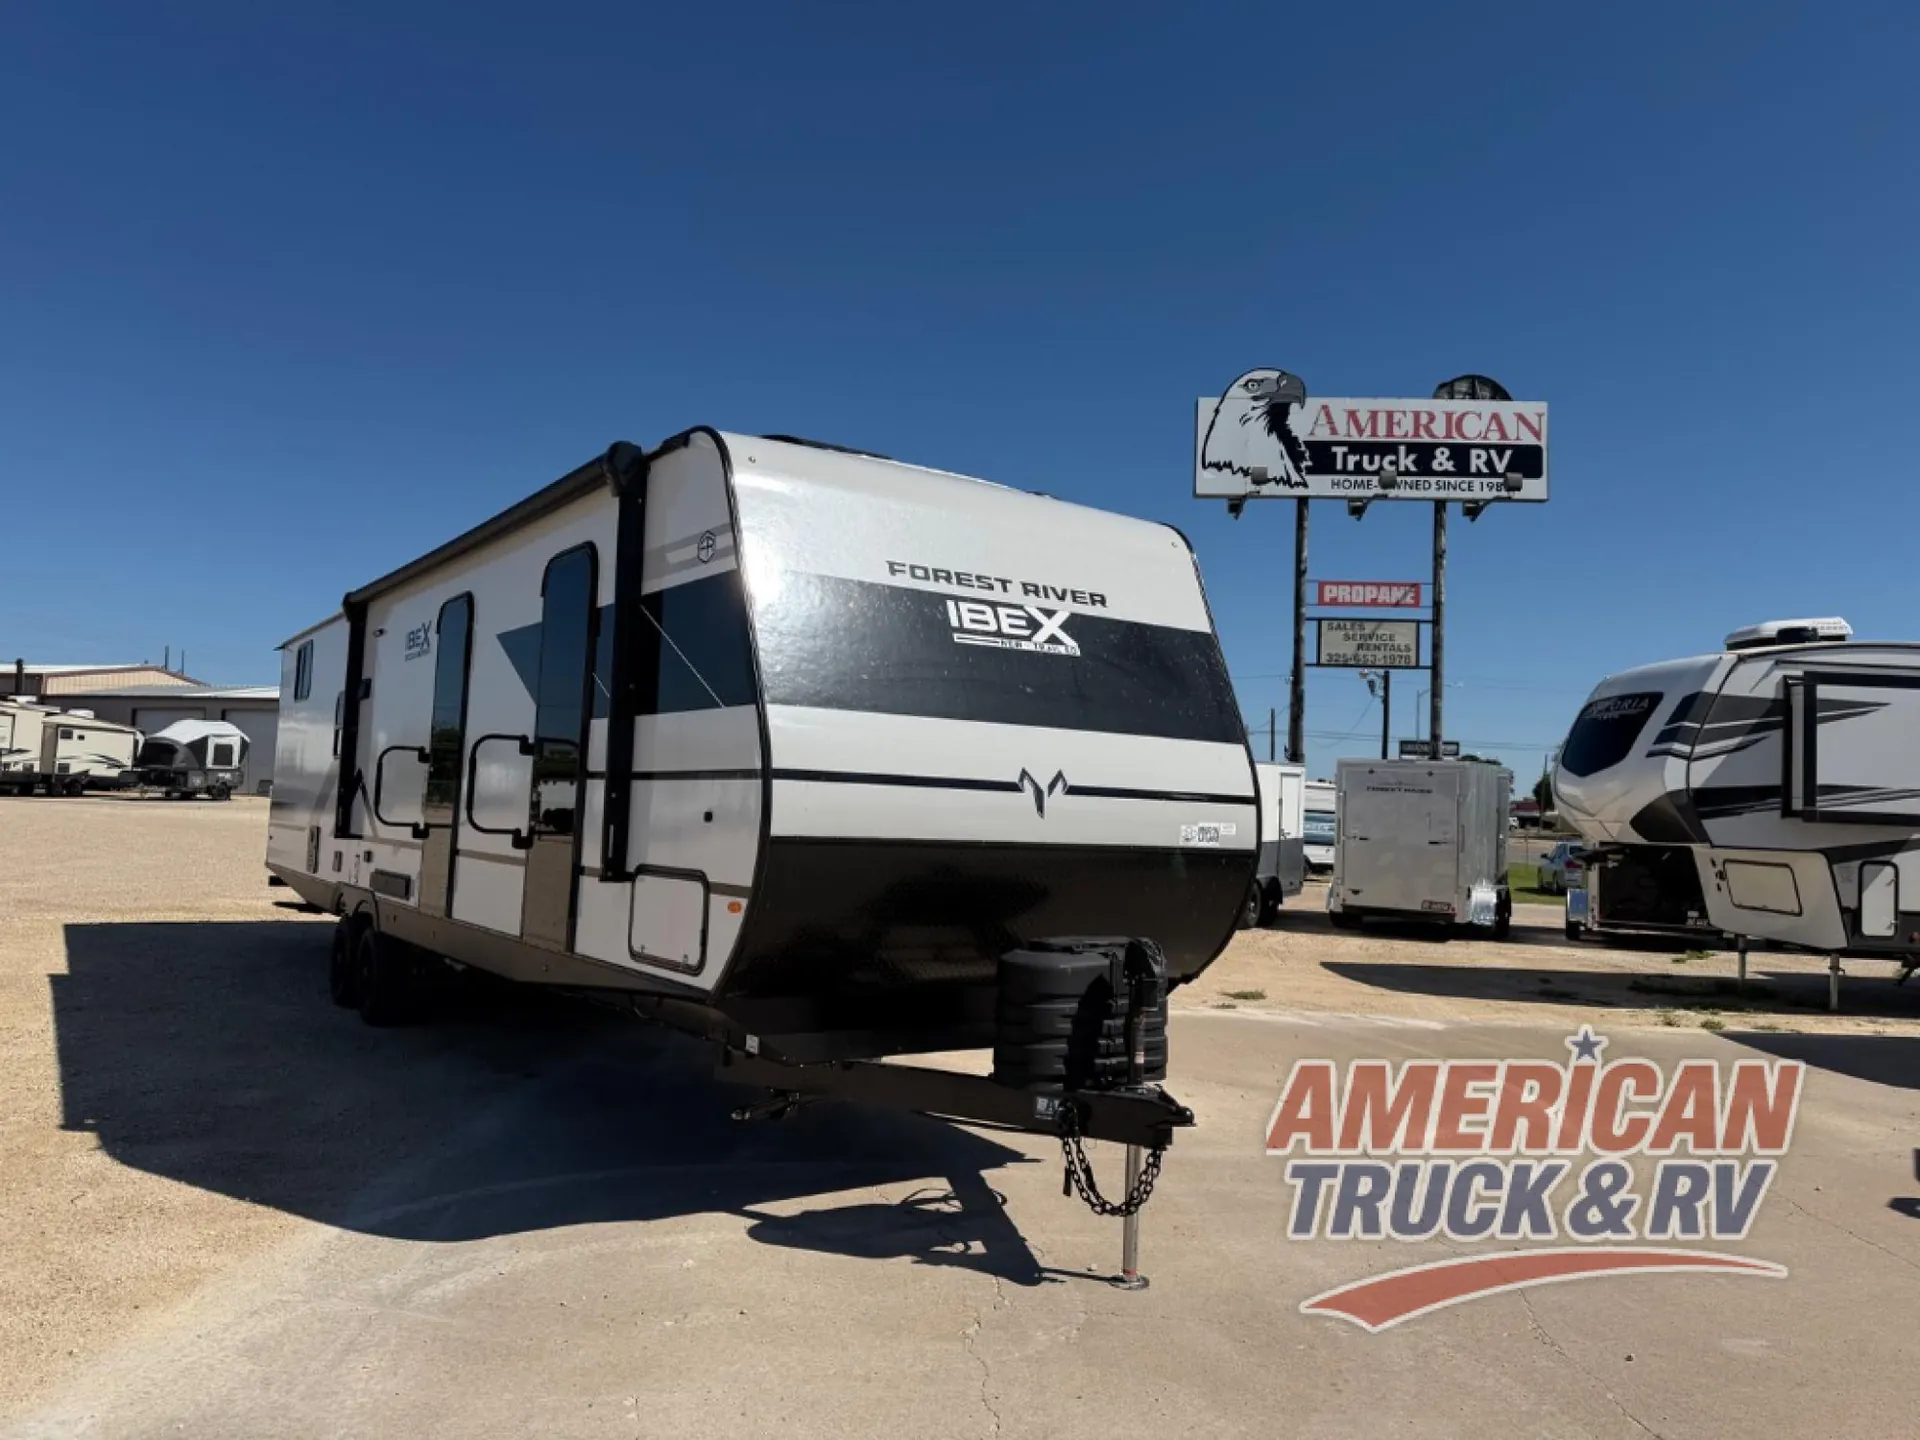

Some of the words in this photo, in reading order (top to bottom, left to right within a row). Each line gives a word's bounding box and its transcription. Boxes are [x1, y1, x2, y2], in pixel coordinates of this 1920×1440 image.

[1308, 403, 1545, 442] AMERICAN
[1331, 445, 1418, 473] Truck
[1432, 447, 1456, 472] &
[1469, 449, 1513, 474] RV
[1331, 478, 1431, 491] HOME-WNED
[1434, 479, 1475, 493] SINCE
[1479, 481, 1505, 493] 198
[886, 560, 1012, 594] FOREST
[1019, 580, 1108, 609] RIVER
[1323, 584, 1416, 604] PROPANE
[946, 599, 1080, 648] IBEX
[1327, 621, 1366, 632] SALES
[1342, 631, 1396, 642] SERVICE
[1356, 643, 1412, 654] RENTALS
